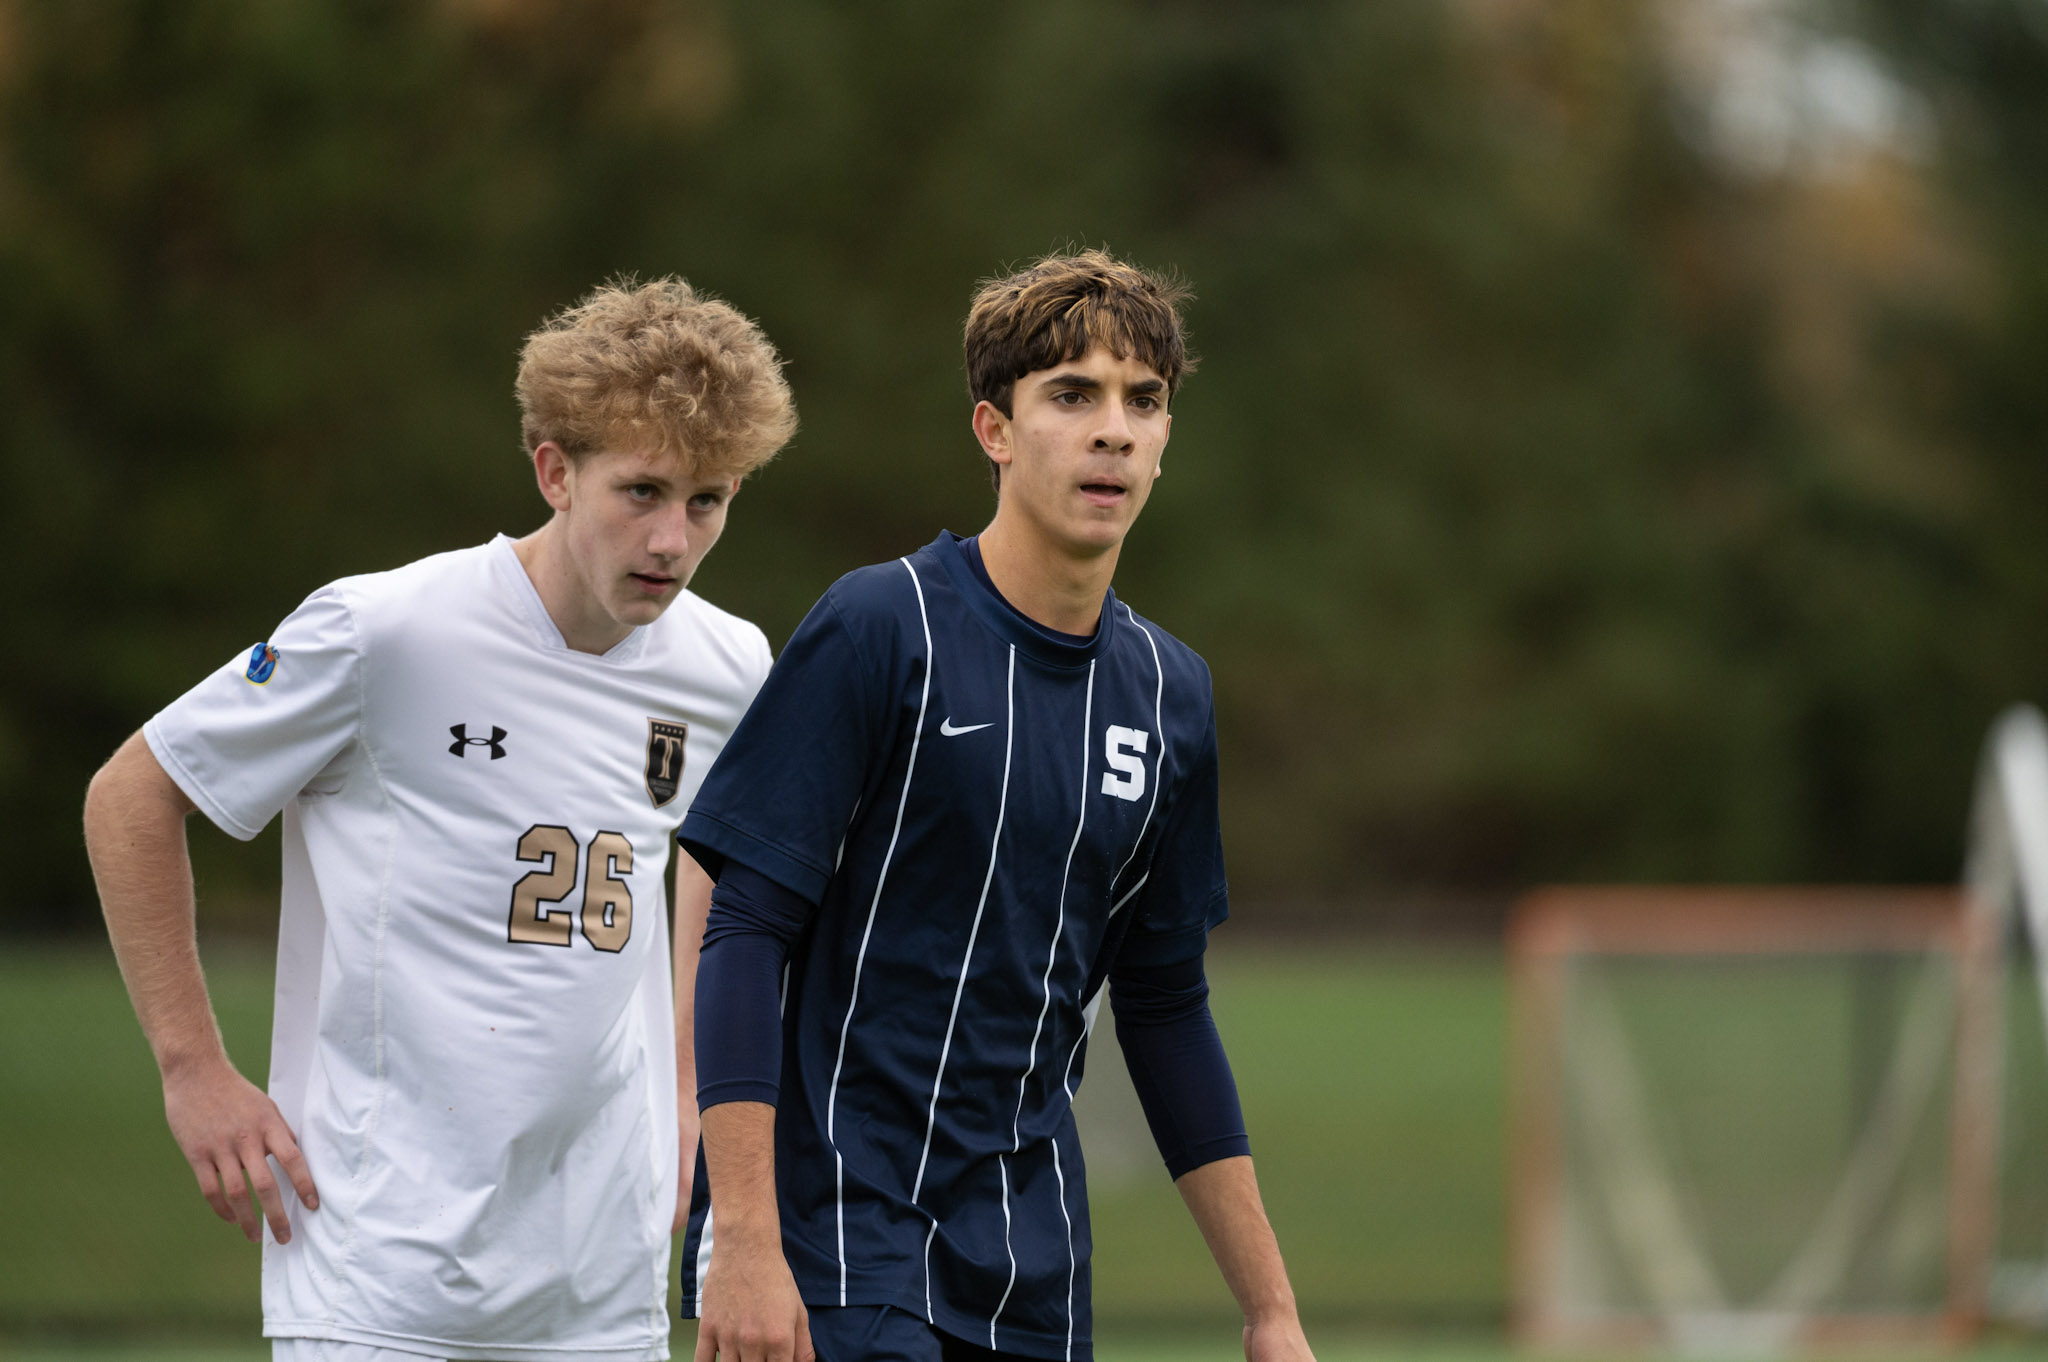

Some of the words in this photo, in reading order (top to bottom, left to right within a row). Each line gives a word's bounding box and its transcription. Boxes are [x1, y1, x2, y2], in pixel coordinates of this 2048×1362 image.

[653, 733, 682, 780] T
[1101, 724, 1149, 802] S
[508, 823, 633, 953] 26
